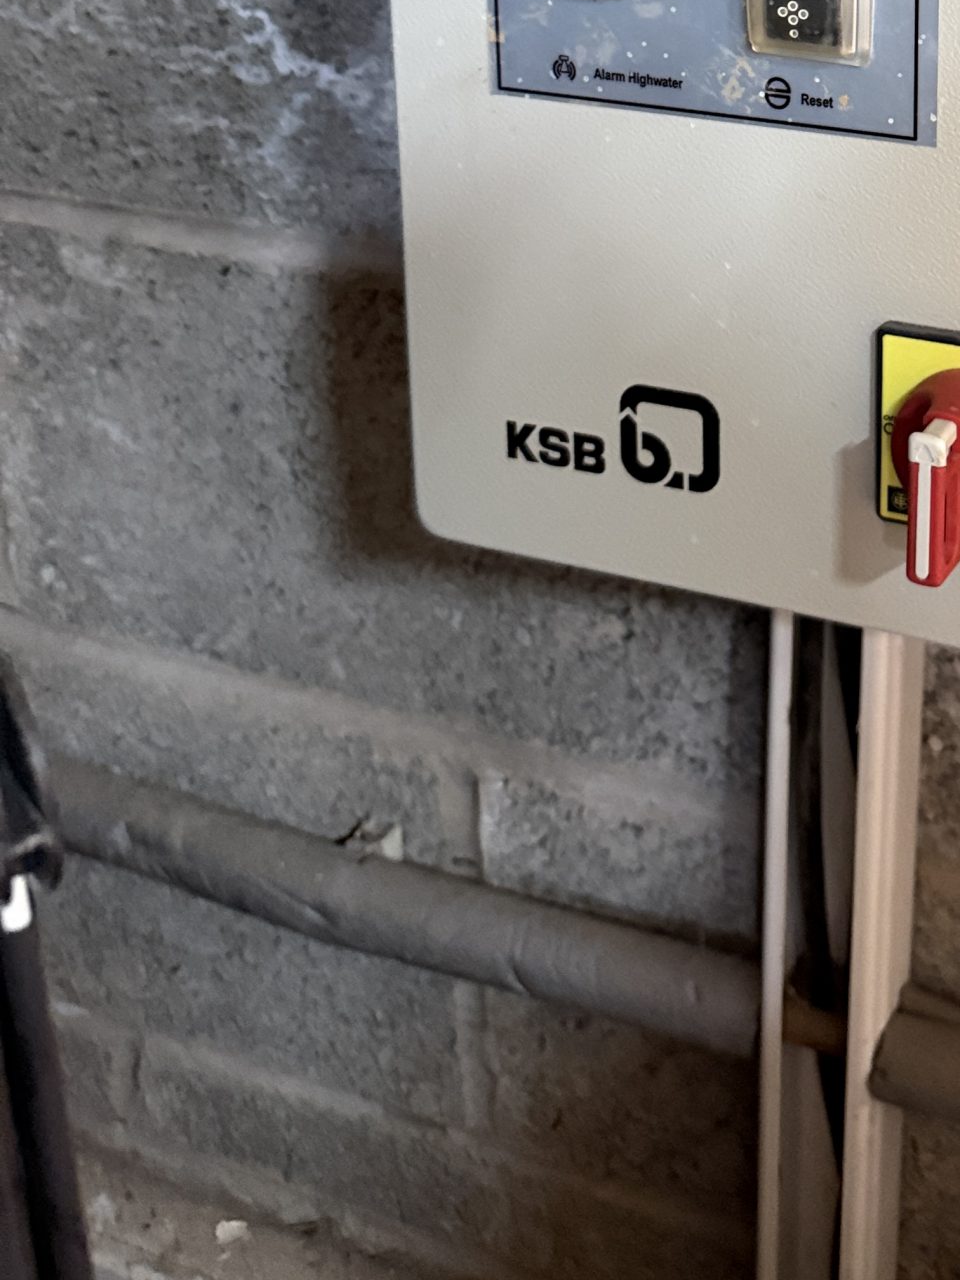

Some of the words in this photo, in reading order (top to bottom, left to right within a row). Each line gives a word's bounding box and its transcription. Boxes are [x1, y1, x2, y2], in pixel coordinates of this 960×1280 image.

[593, 68, 626, 83] Alarm
[628, 71, 683, 89] Highwater
[800, 93, 834, 109] Reset
[505, 420, 605, 474] KSB
